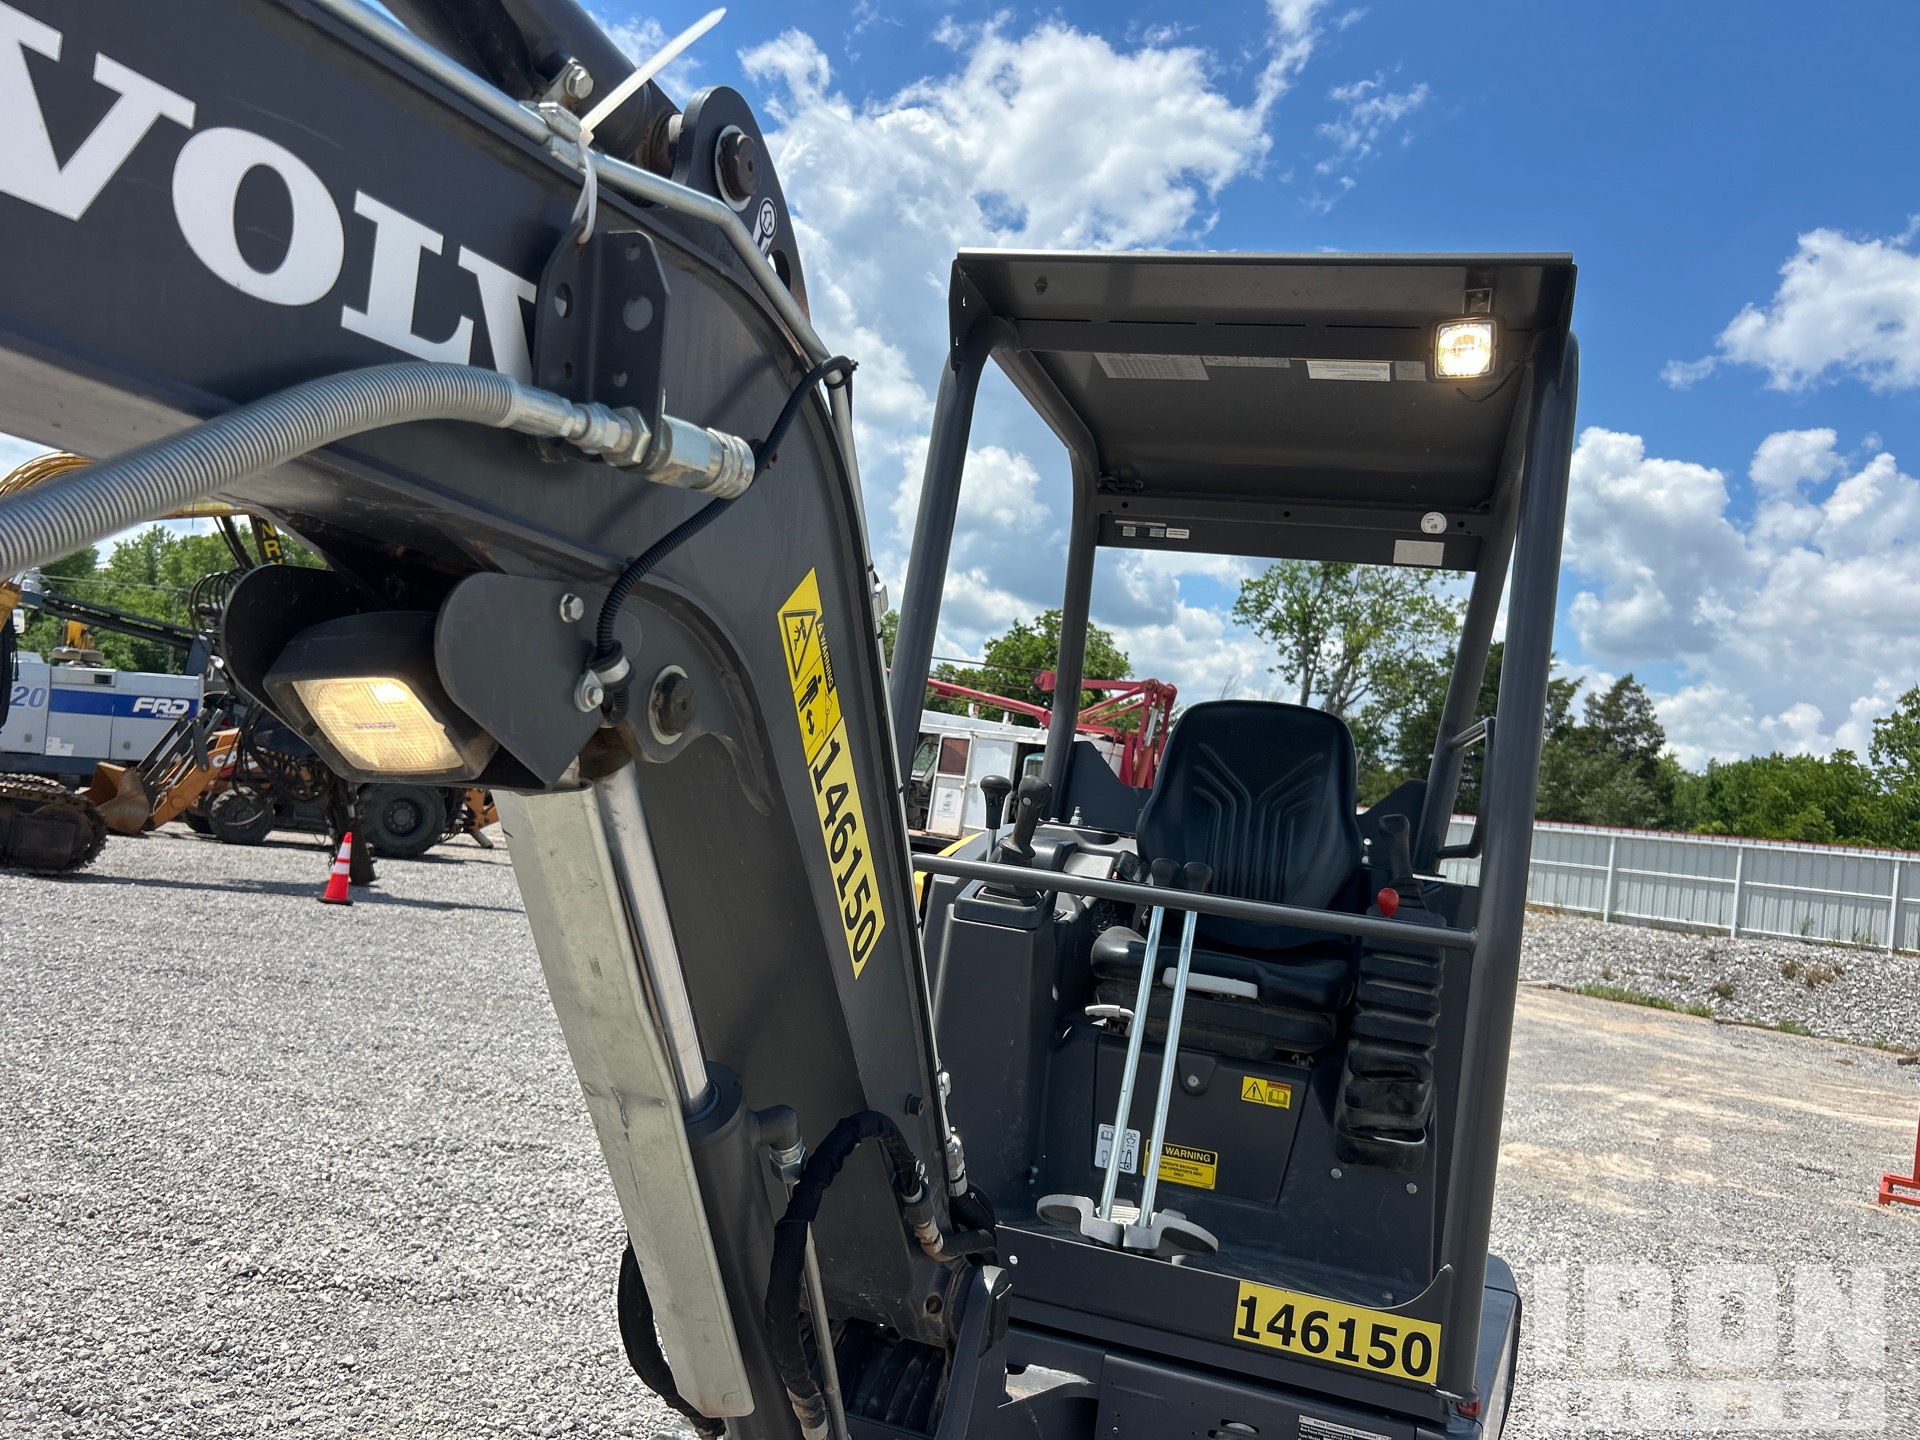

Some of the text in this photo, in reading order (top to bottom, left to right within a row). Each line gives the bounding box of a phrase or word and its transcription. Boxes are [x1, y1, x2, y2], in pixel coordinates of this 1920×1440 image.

[820, 633, 834, 689] WARNING
[133, 697, 190, 714] FRD
[812, 740, 878, 965] 146150
[1165, 1146, 1211, 1163] WARNING
[1237, 1295, 1433, 1378] 146150
